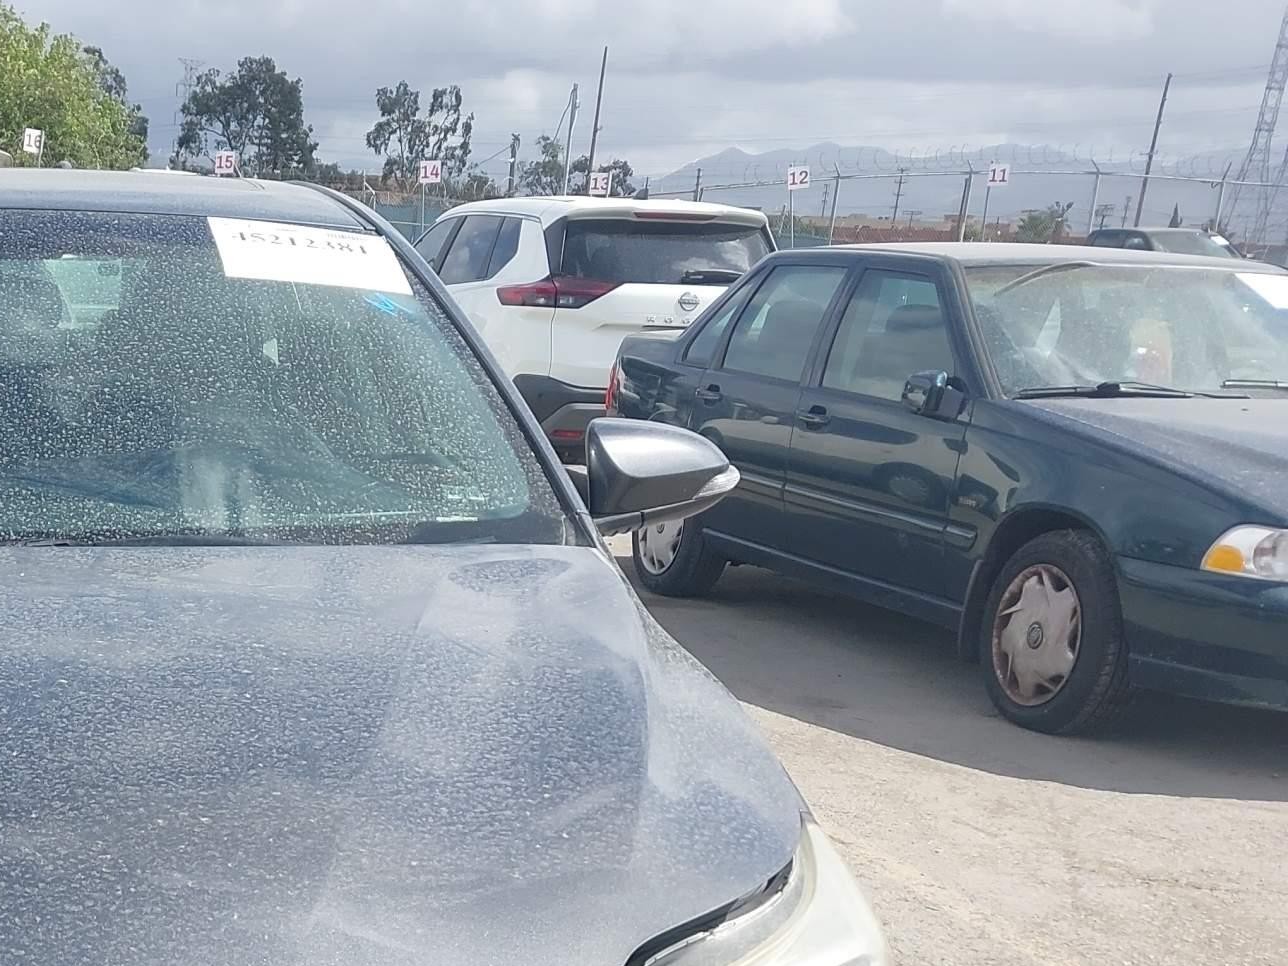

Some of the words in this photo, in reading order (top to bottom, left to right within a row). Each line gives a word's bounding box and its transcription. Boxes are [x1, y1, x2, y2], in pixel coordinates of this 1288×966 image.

[26, 132, 41, 149] 16
[216, 155, 234, 169] 15
[421, 164, 440, 179] 14
[789, 170, 809, 186] 12
[988, 167, 1008, 183] 11
[591, 176, 608, 190] 13
